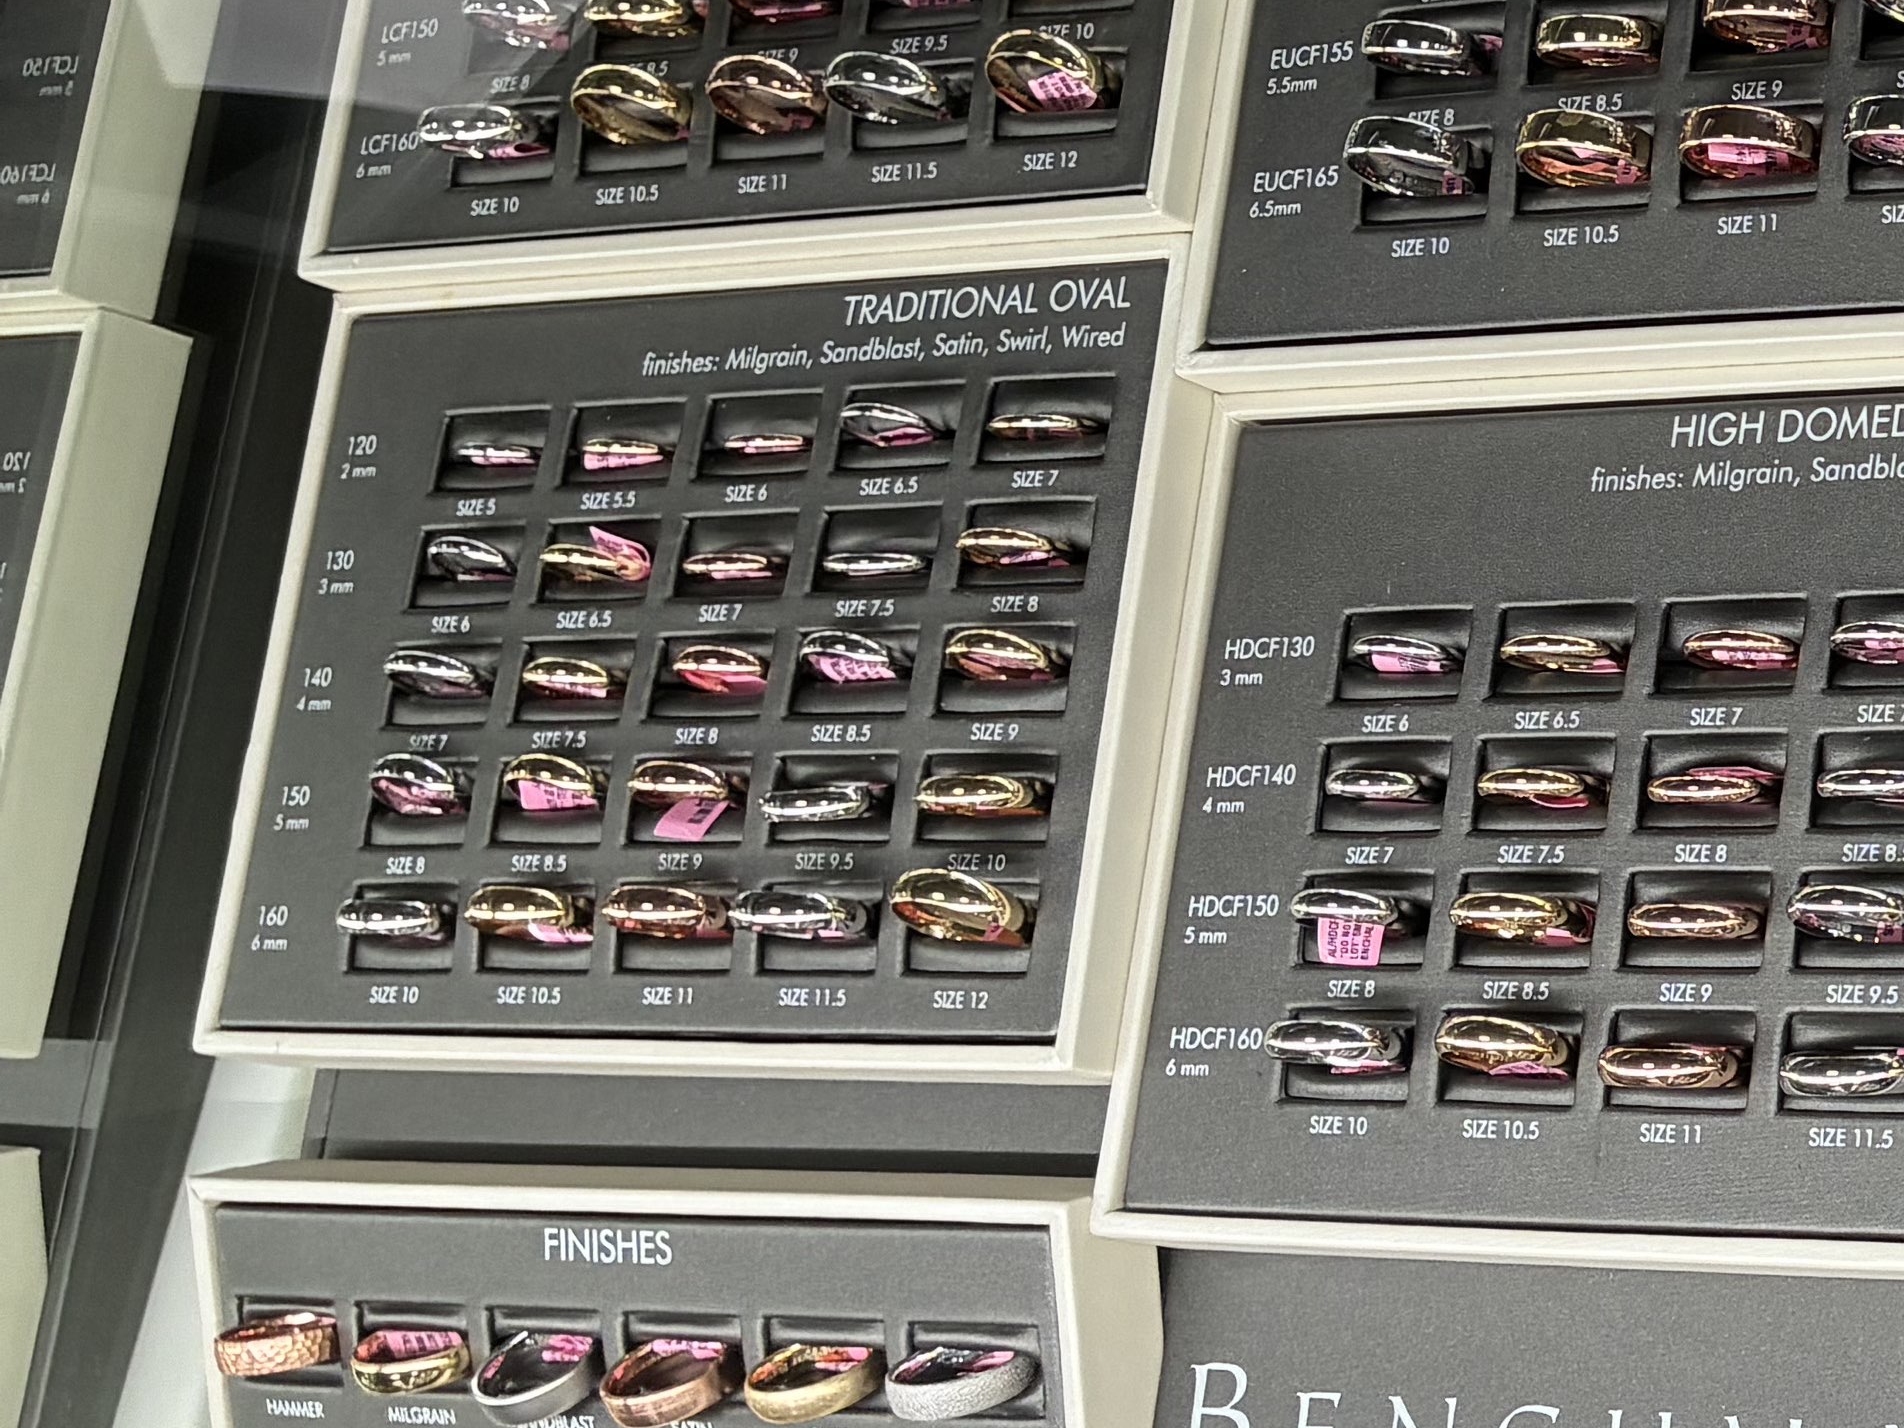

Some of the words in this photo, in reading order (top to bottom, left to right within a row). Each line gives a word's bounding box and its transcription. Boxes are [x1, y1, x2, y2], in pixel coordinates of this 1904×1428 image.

[381, 17, 439, 44] LCF150
[889, 36, 922, 55] SIZE
[924, 34, 948, 52] 9.5
[1270, 40, 1354, 70] EUCF155
[1266, 76, 1318, 95] 5.5mm
[361, 132, 418, 155] LCF160
[871, 164, 902, 183] SIZE
[906, 161, 938, 181] 11.5
[1022, 152, 1055, 172] SIZE
[1060, 150, 1078, 168] 12
[1253, 165, 1339, 193] EUCF165
[1249, 200, 1302, 219] 6.5mm
[1716, 215, 1753, 235] SIZE
[1759, 213, 1777, 232] 11
[1391, 238, 1425, 258] SIZE
[1430, 236, 1450, 255] 10
[844, 282, 1038, 326] TRADITIONAL
[1049, 275, 1131, 312] OVAL
[642, 350, 720, 376] finishes:
[724, 343, 813, 375] Milgrain,
[819, 335, 925, 364] Sandblast,
[932, 331, 989, 358] Satin,
[996, 325, 1052, 355] Swirl,
[1062, 321, 1127, 348] Wired
[1670, 410, 1766, 448] HIGH
[348, 434, 377, 456] 120
[1590, 464, 1684, 493] finishes:
[1692, 458, 1801, 492] Milgrain,
[326, 549, 355, 571] 130
[1224, 635, 1315, 660] HDCF130
[304, 666, 333, 688] 140
[1219, 668, 1232, 686] 3
[1206, 763, 1297, 788] HDCF140
[281, 785, 311, 807] 150
[259, 905, 289, 927] 160
[1188, 894, 1280, 918] HDCF150
[250, 934, 261, 951] 6
[1183, 926, 1196, 945] 5
[369, 985, 399, 1004] SIZE
[402, 986, 420, 1004] 10
[641, 986, 673, 1005] SIZE
[678, 987, 693, 1005] 11
[932, 990, 965, 1009] SIZE
[970, 991, 989, 1009] 12
[1169, 1026, 1263, 1050] HDCF160
[1165, 1058, 1177, 1077] 6
[1309, 1115, 1343, 1135] SIZE
[1347, 1116, 1368, 1136] 10
[1808, 1127, 1847, 1147] SIZE
[1853, 1128, 1894, 1149] 11.5
[543, 1227, 673, 1266] FINISHES
[265, 1398, 325, 1419] HAMMER
[387, 1406, 457, 1425] MILGRAIN
